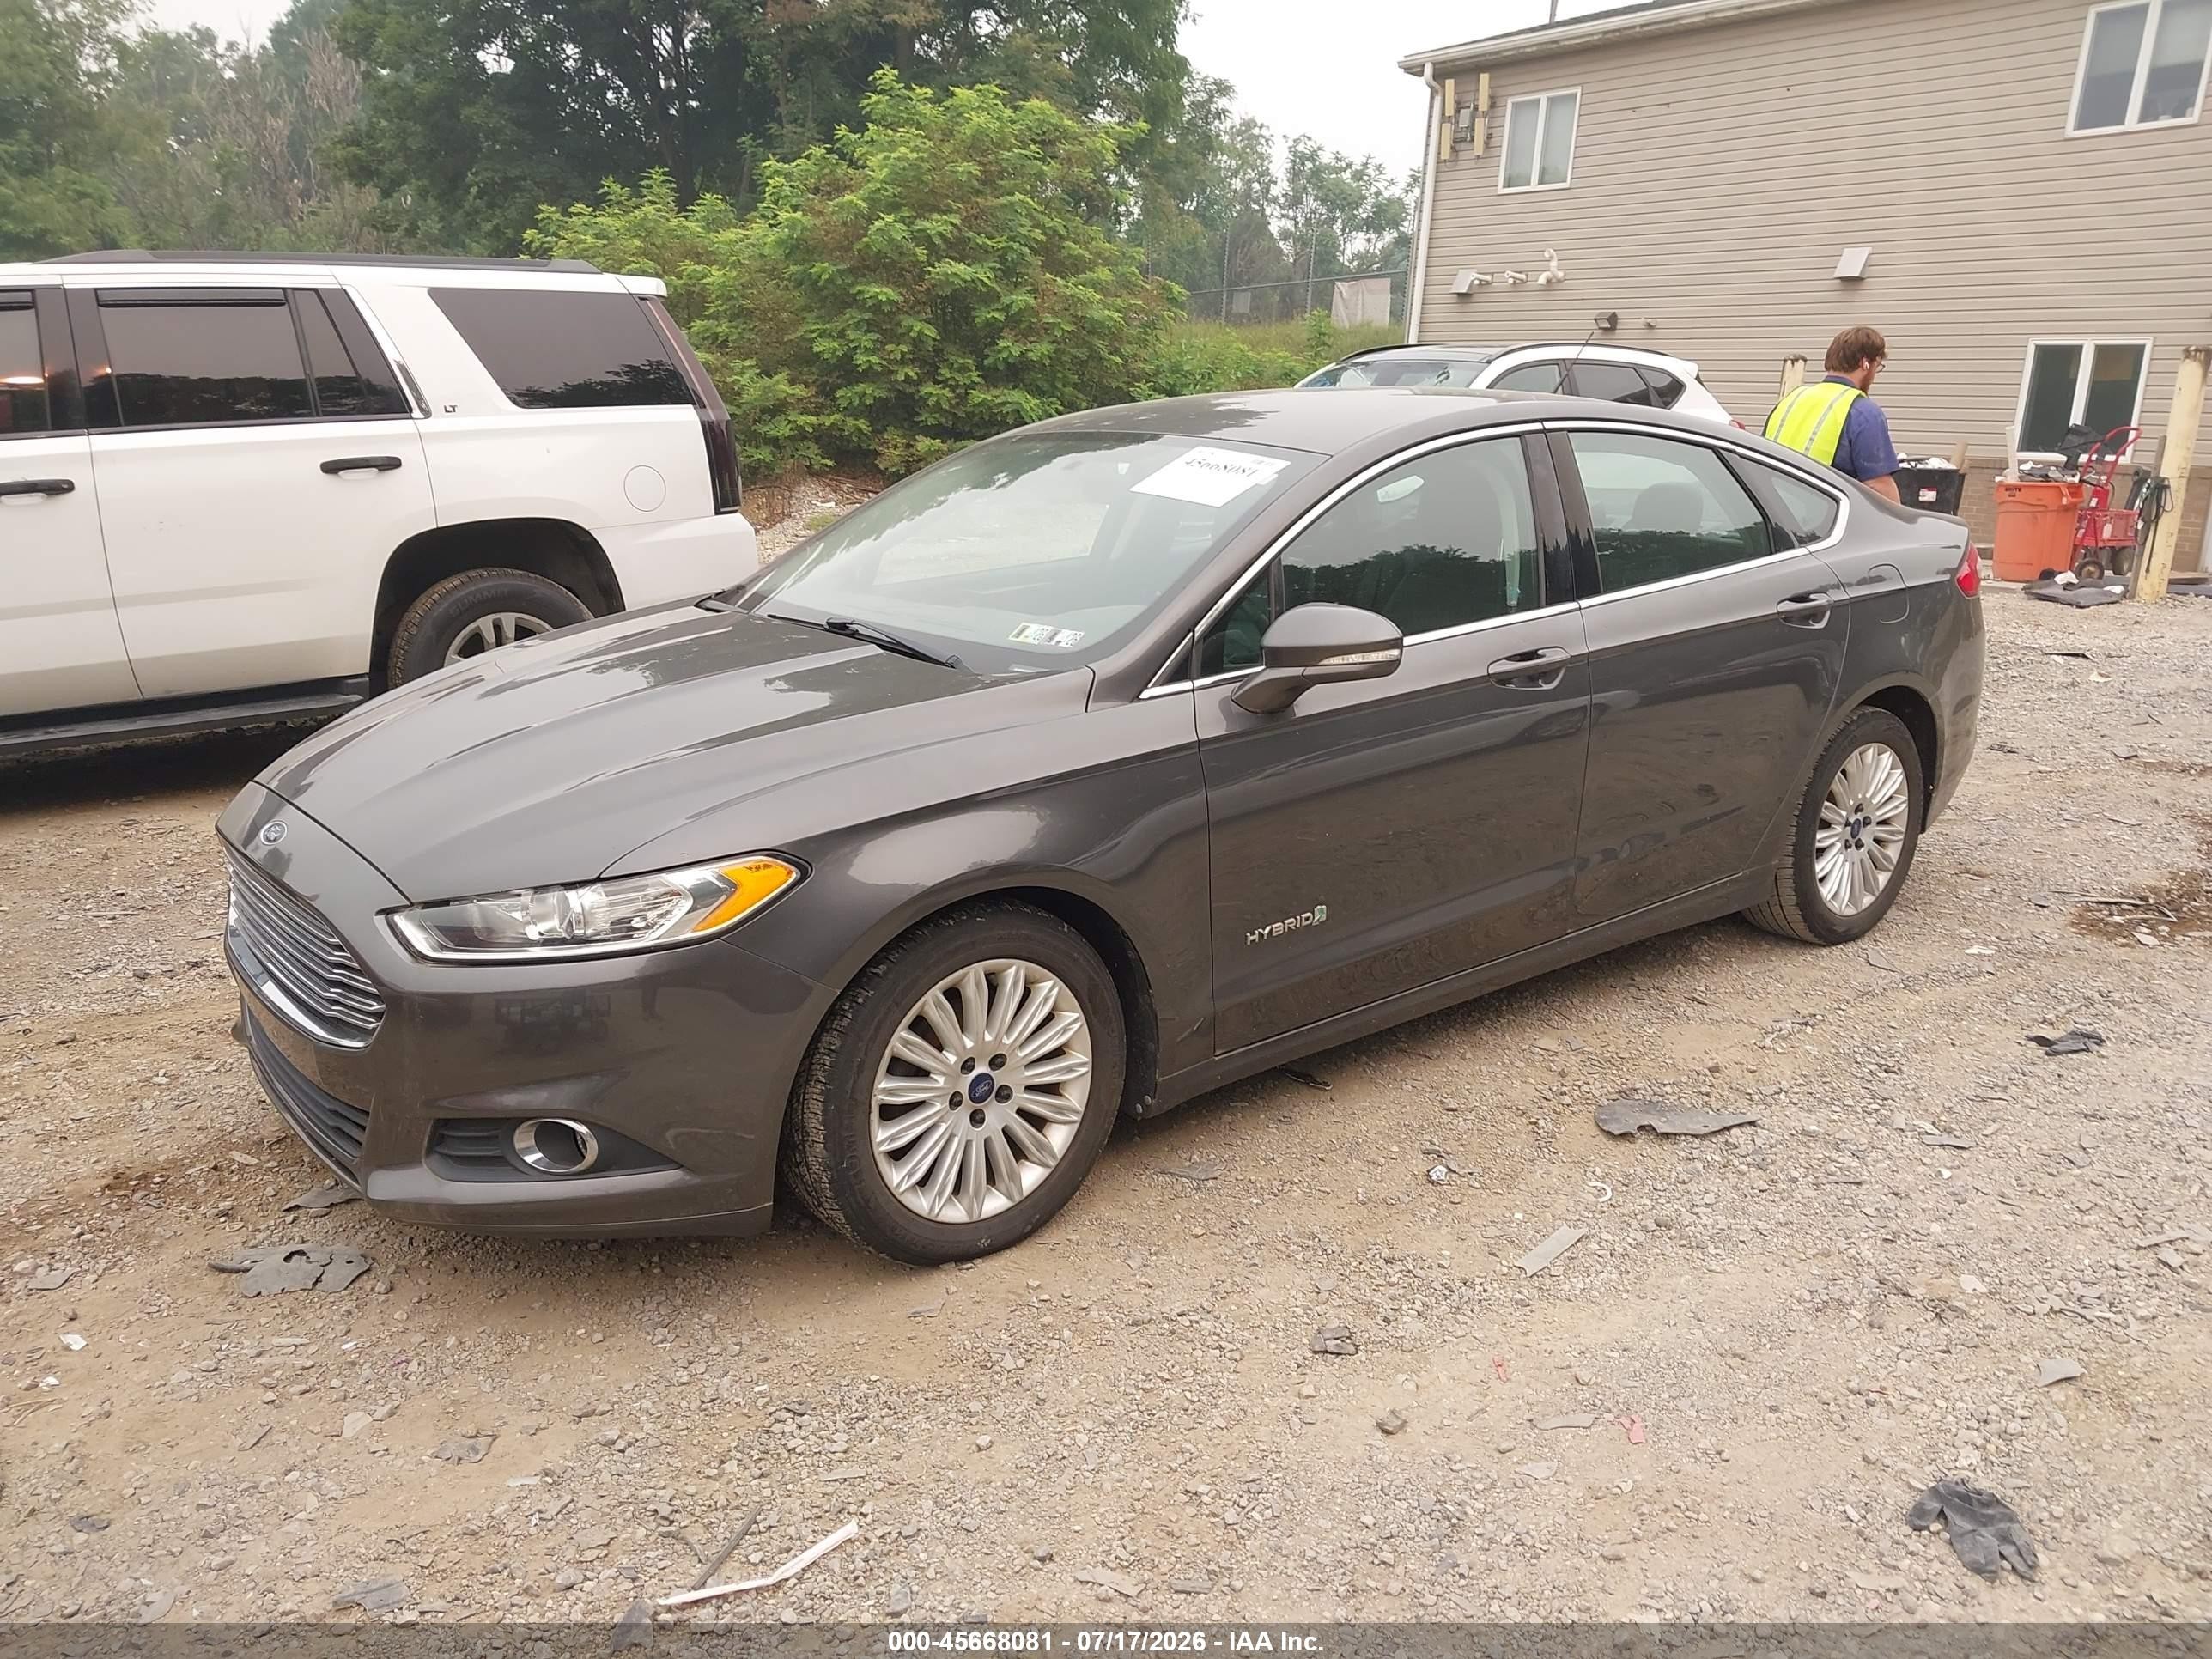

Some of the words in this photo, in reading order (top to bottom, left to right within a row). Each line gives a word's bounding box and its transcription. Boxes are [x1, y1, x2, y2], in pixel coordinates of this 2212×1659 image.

[443, 404, 458, 413] LT
[1245, 912, 1314, 945] HYBRID
[971, 1080, 992, 1098] Ford
